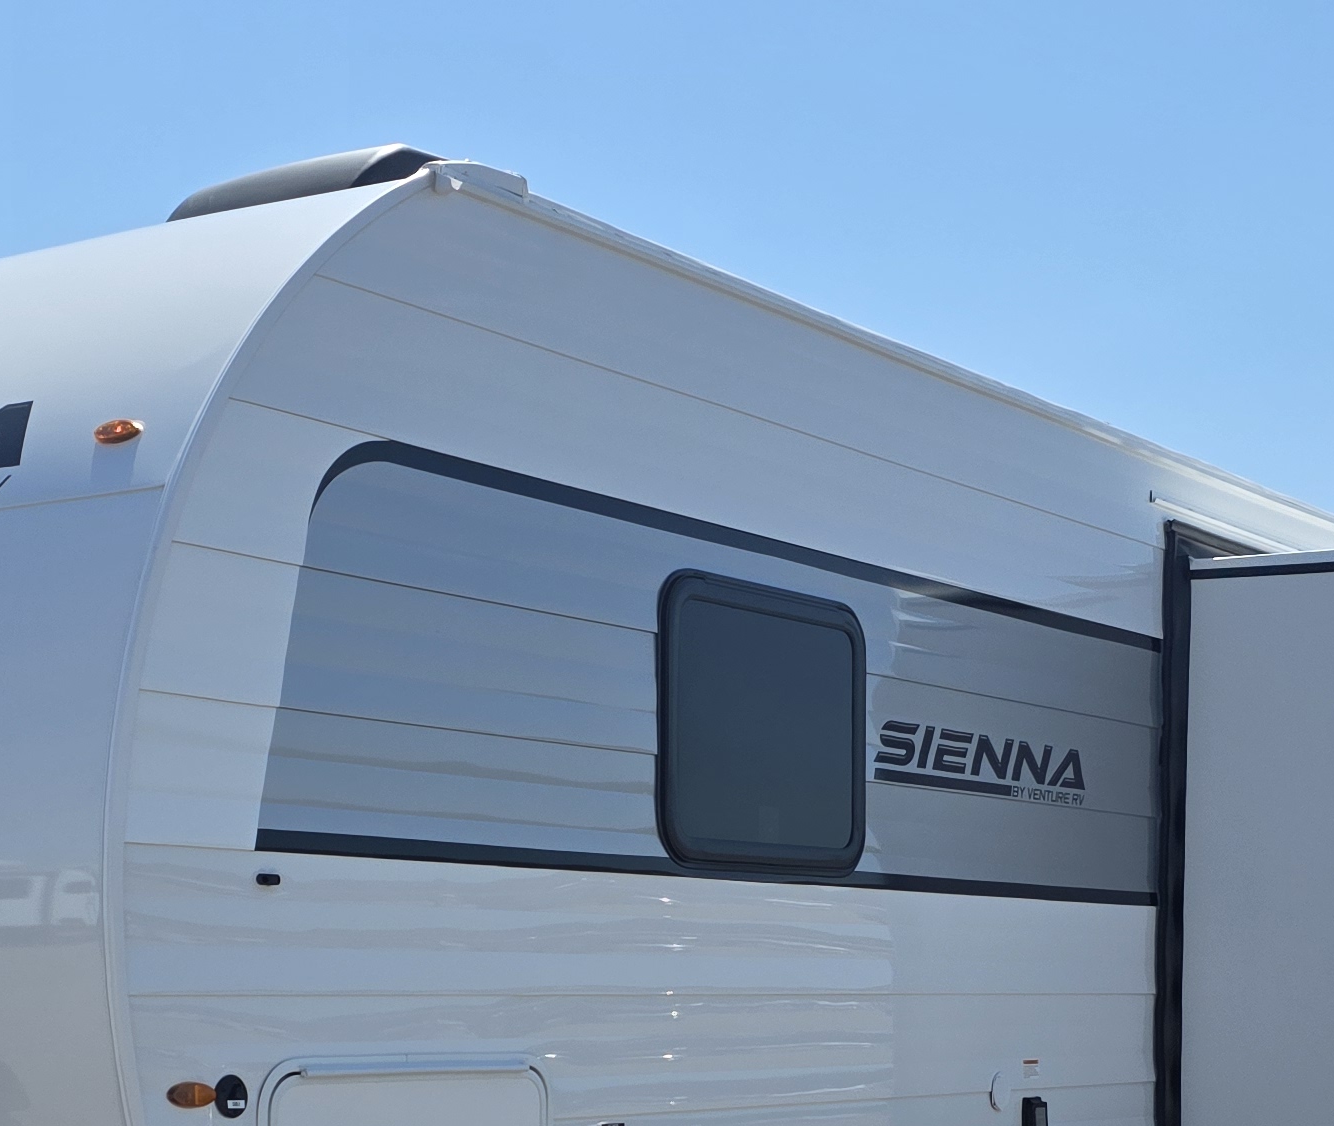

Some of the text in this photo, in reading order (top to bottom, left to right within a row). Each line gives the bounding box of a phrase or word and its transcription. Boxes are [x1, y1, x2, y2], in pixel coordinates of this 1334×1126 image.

[873, 719, 1086, 791] SIENNA
[1012, 785, 1085, 806] BY VENTURE RV
